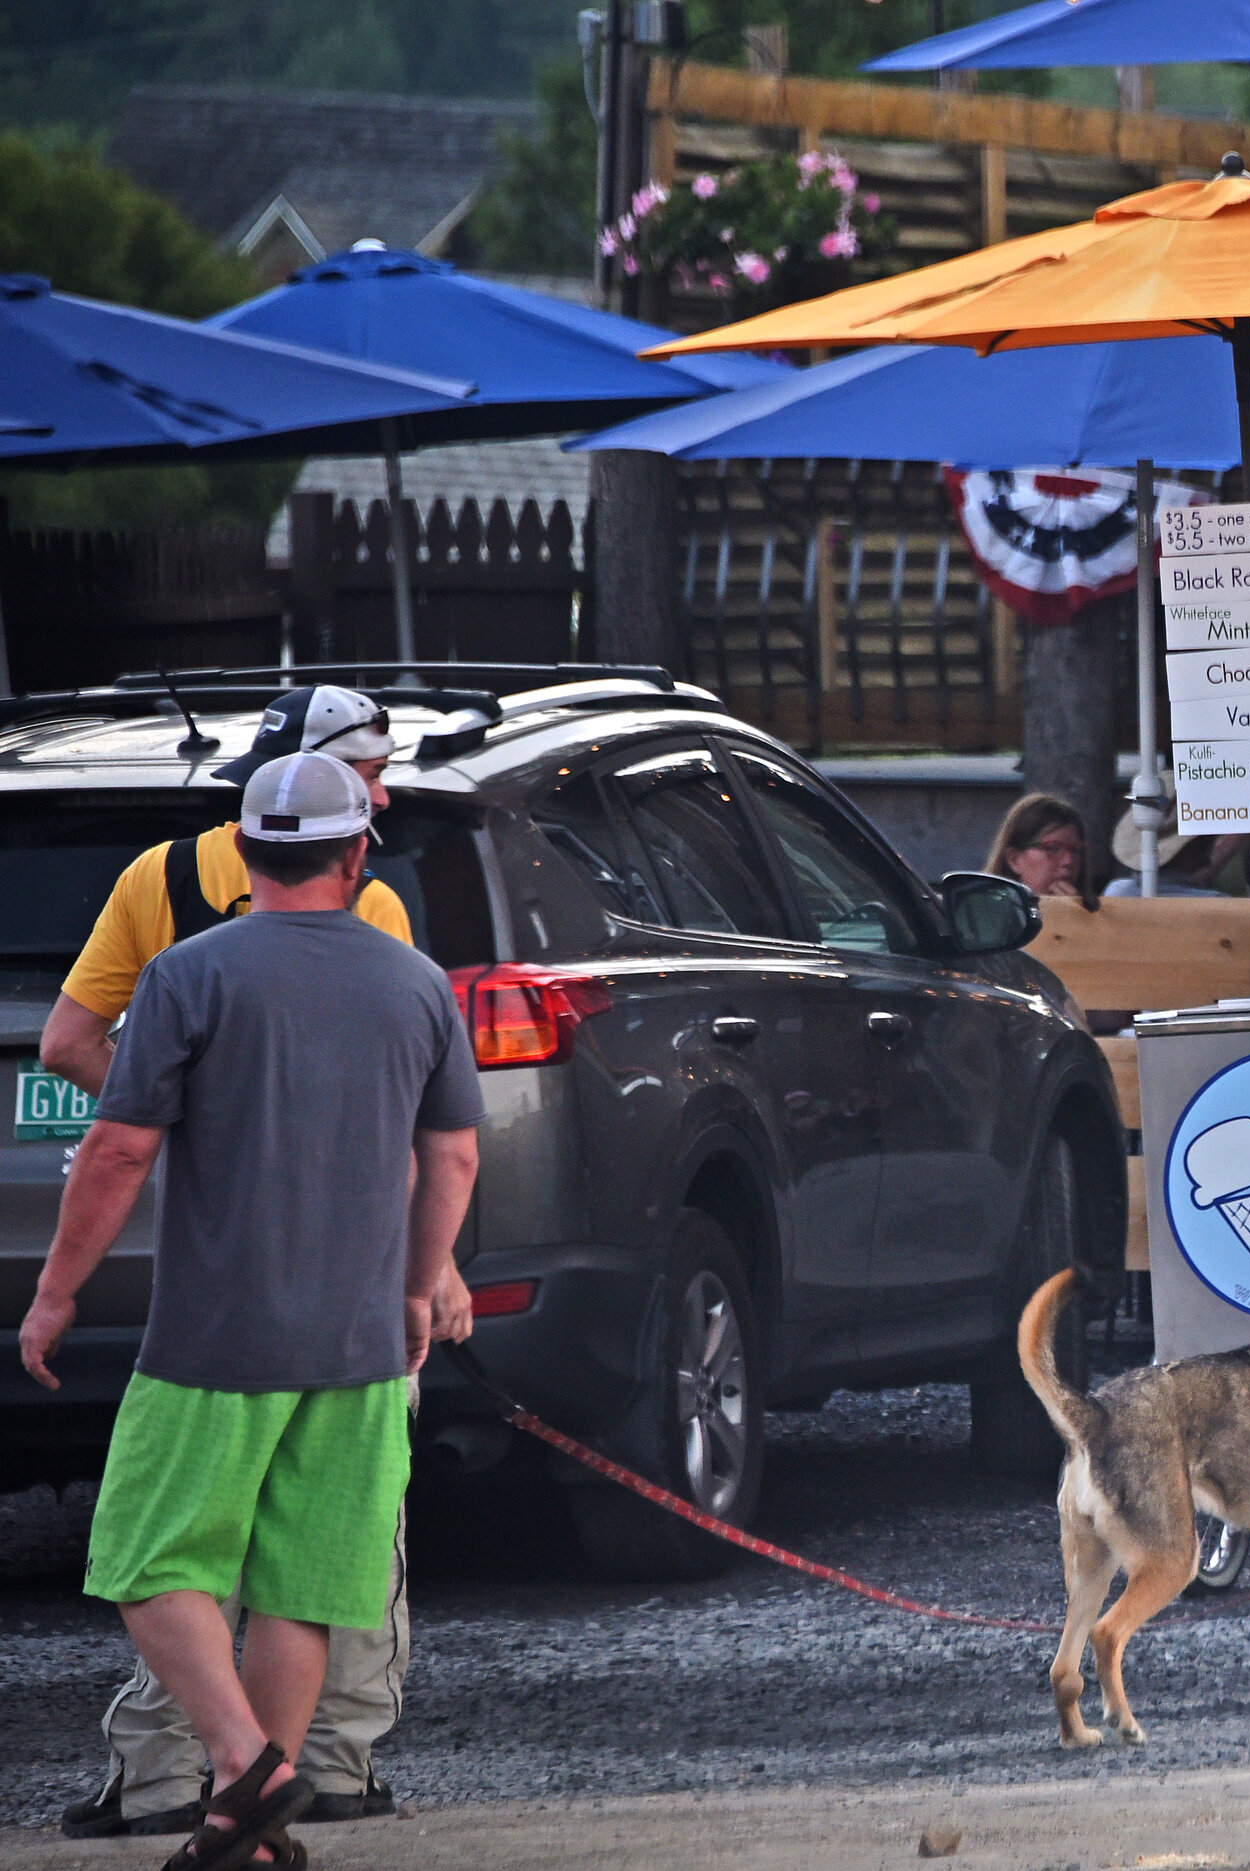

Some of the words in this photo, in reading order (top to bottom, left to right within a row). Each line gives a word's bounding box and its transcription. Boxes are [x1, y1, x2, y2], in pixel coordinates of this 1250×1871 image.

[1166, 511, 1202, 532] $3.5
[1217, 514, 1245, 527] one
[1167, 531, 1204, 551] $5.5
[1219, 533, 1246, 547] two
[1173, 567, 1225, 592] Black
[1170, 605, 1232, 621] Whiteface
[1207, 619, 1250, 641] Mint
[1178, 760, 1247, 781] Pistachio
[1180, 802, 1249, 822] Banana
